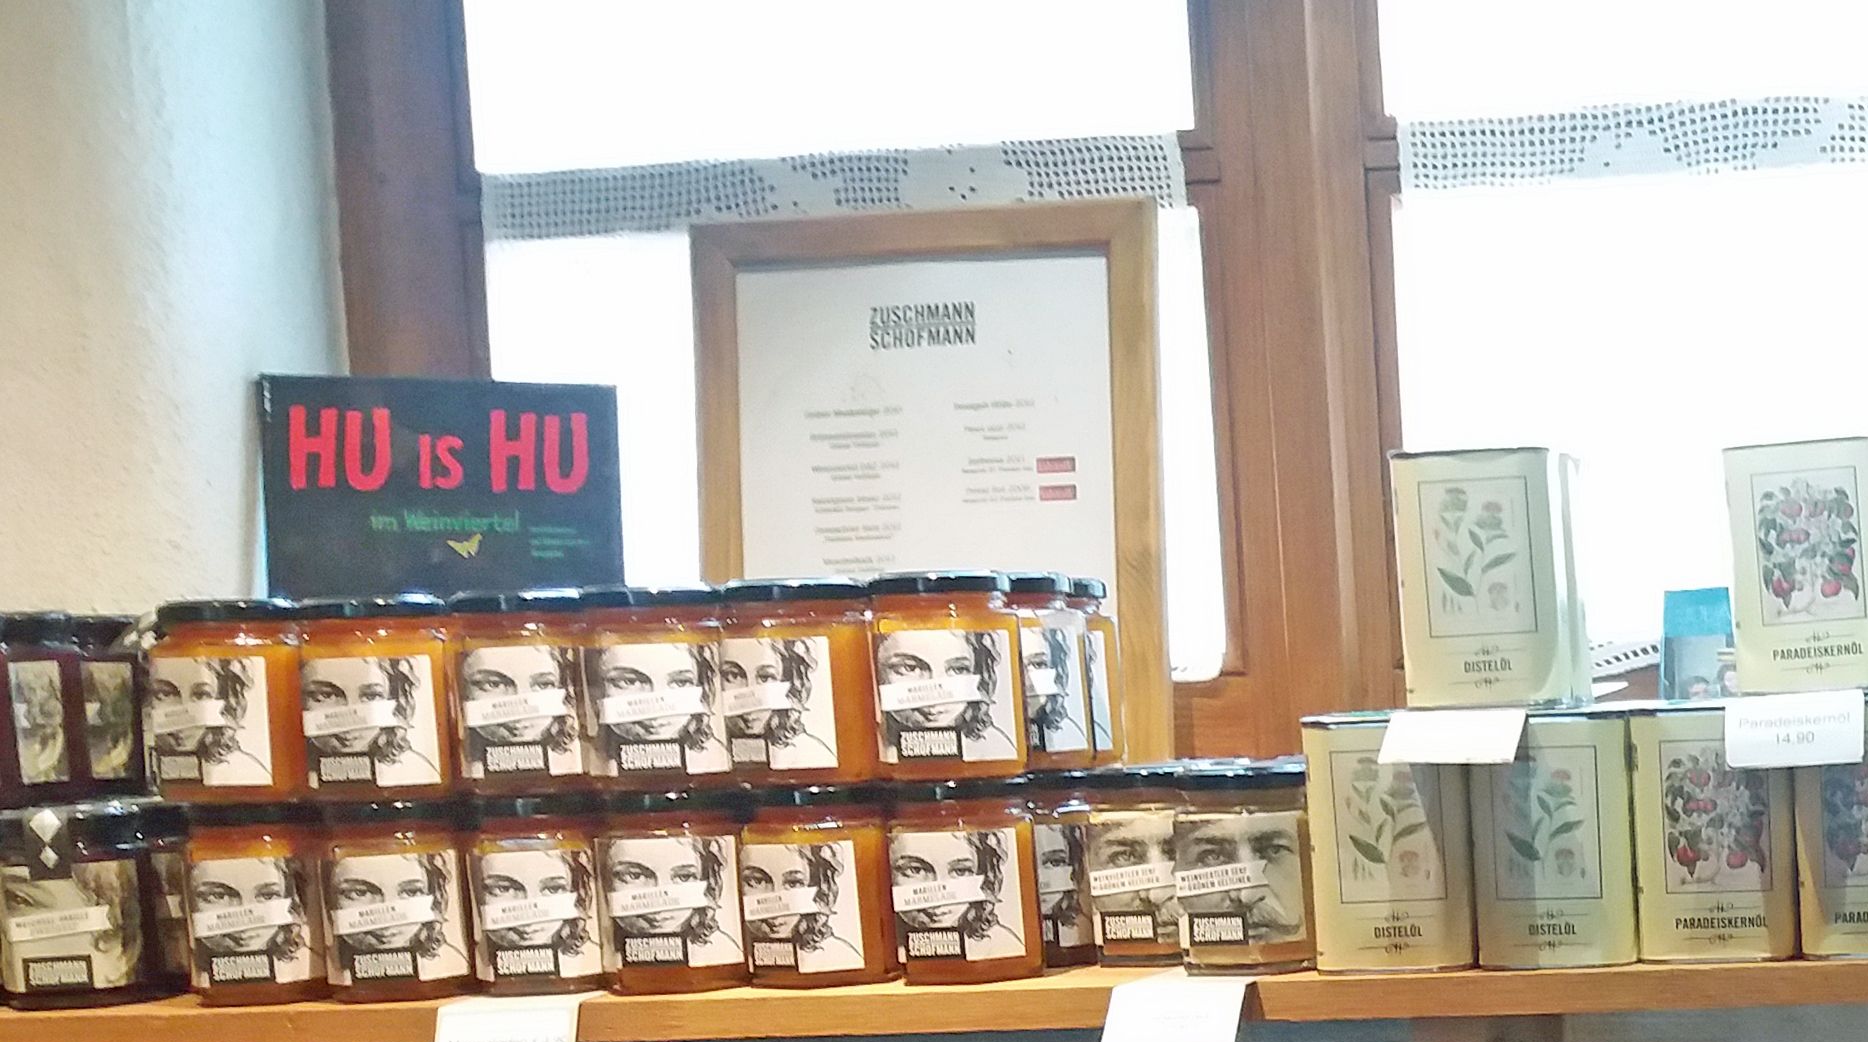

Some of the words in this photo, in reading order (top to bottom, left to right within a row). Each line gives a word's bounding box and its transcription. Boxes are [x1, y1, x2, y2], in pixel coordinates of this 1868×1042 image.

[870, 301, 975, 325] ZUSCHMANN
[289, 404, 392, 491] HU
[419, 434, 464, 489] IS
[490, 408, 589, 494] HU
[1772, 641, 1864, 662] PARADEISKERNÖL
[900, 730, 957, 744] ZUSCHMANN
[1528, 920, 1577, 937] DISTELÖL
[1675, 912, 1768, 931] PARADEISKERNÖL
[908, 932, 960, 944] ZUSCHMANN
[1373, 924, 1423, 939] DISTELÖL
[625, 936, 683, 949] ZUSCHMANN
